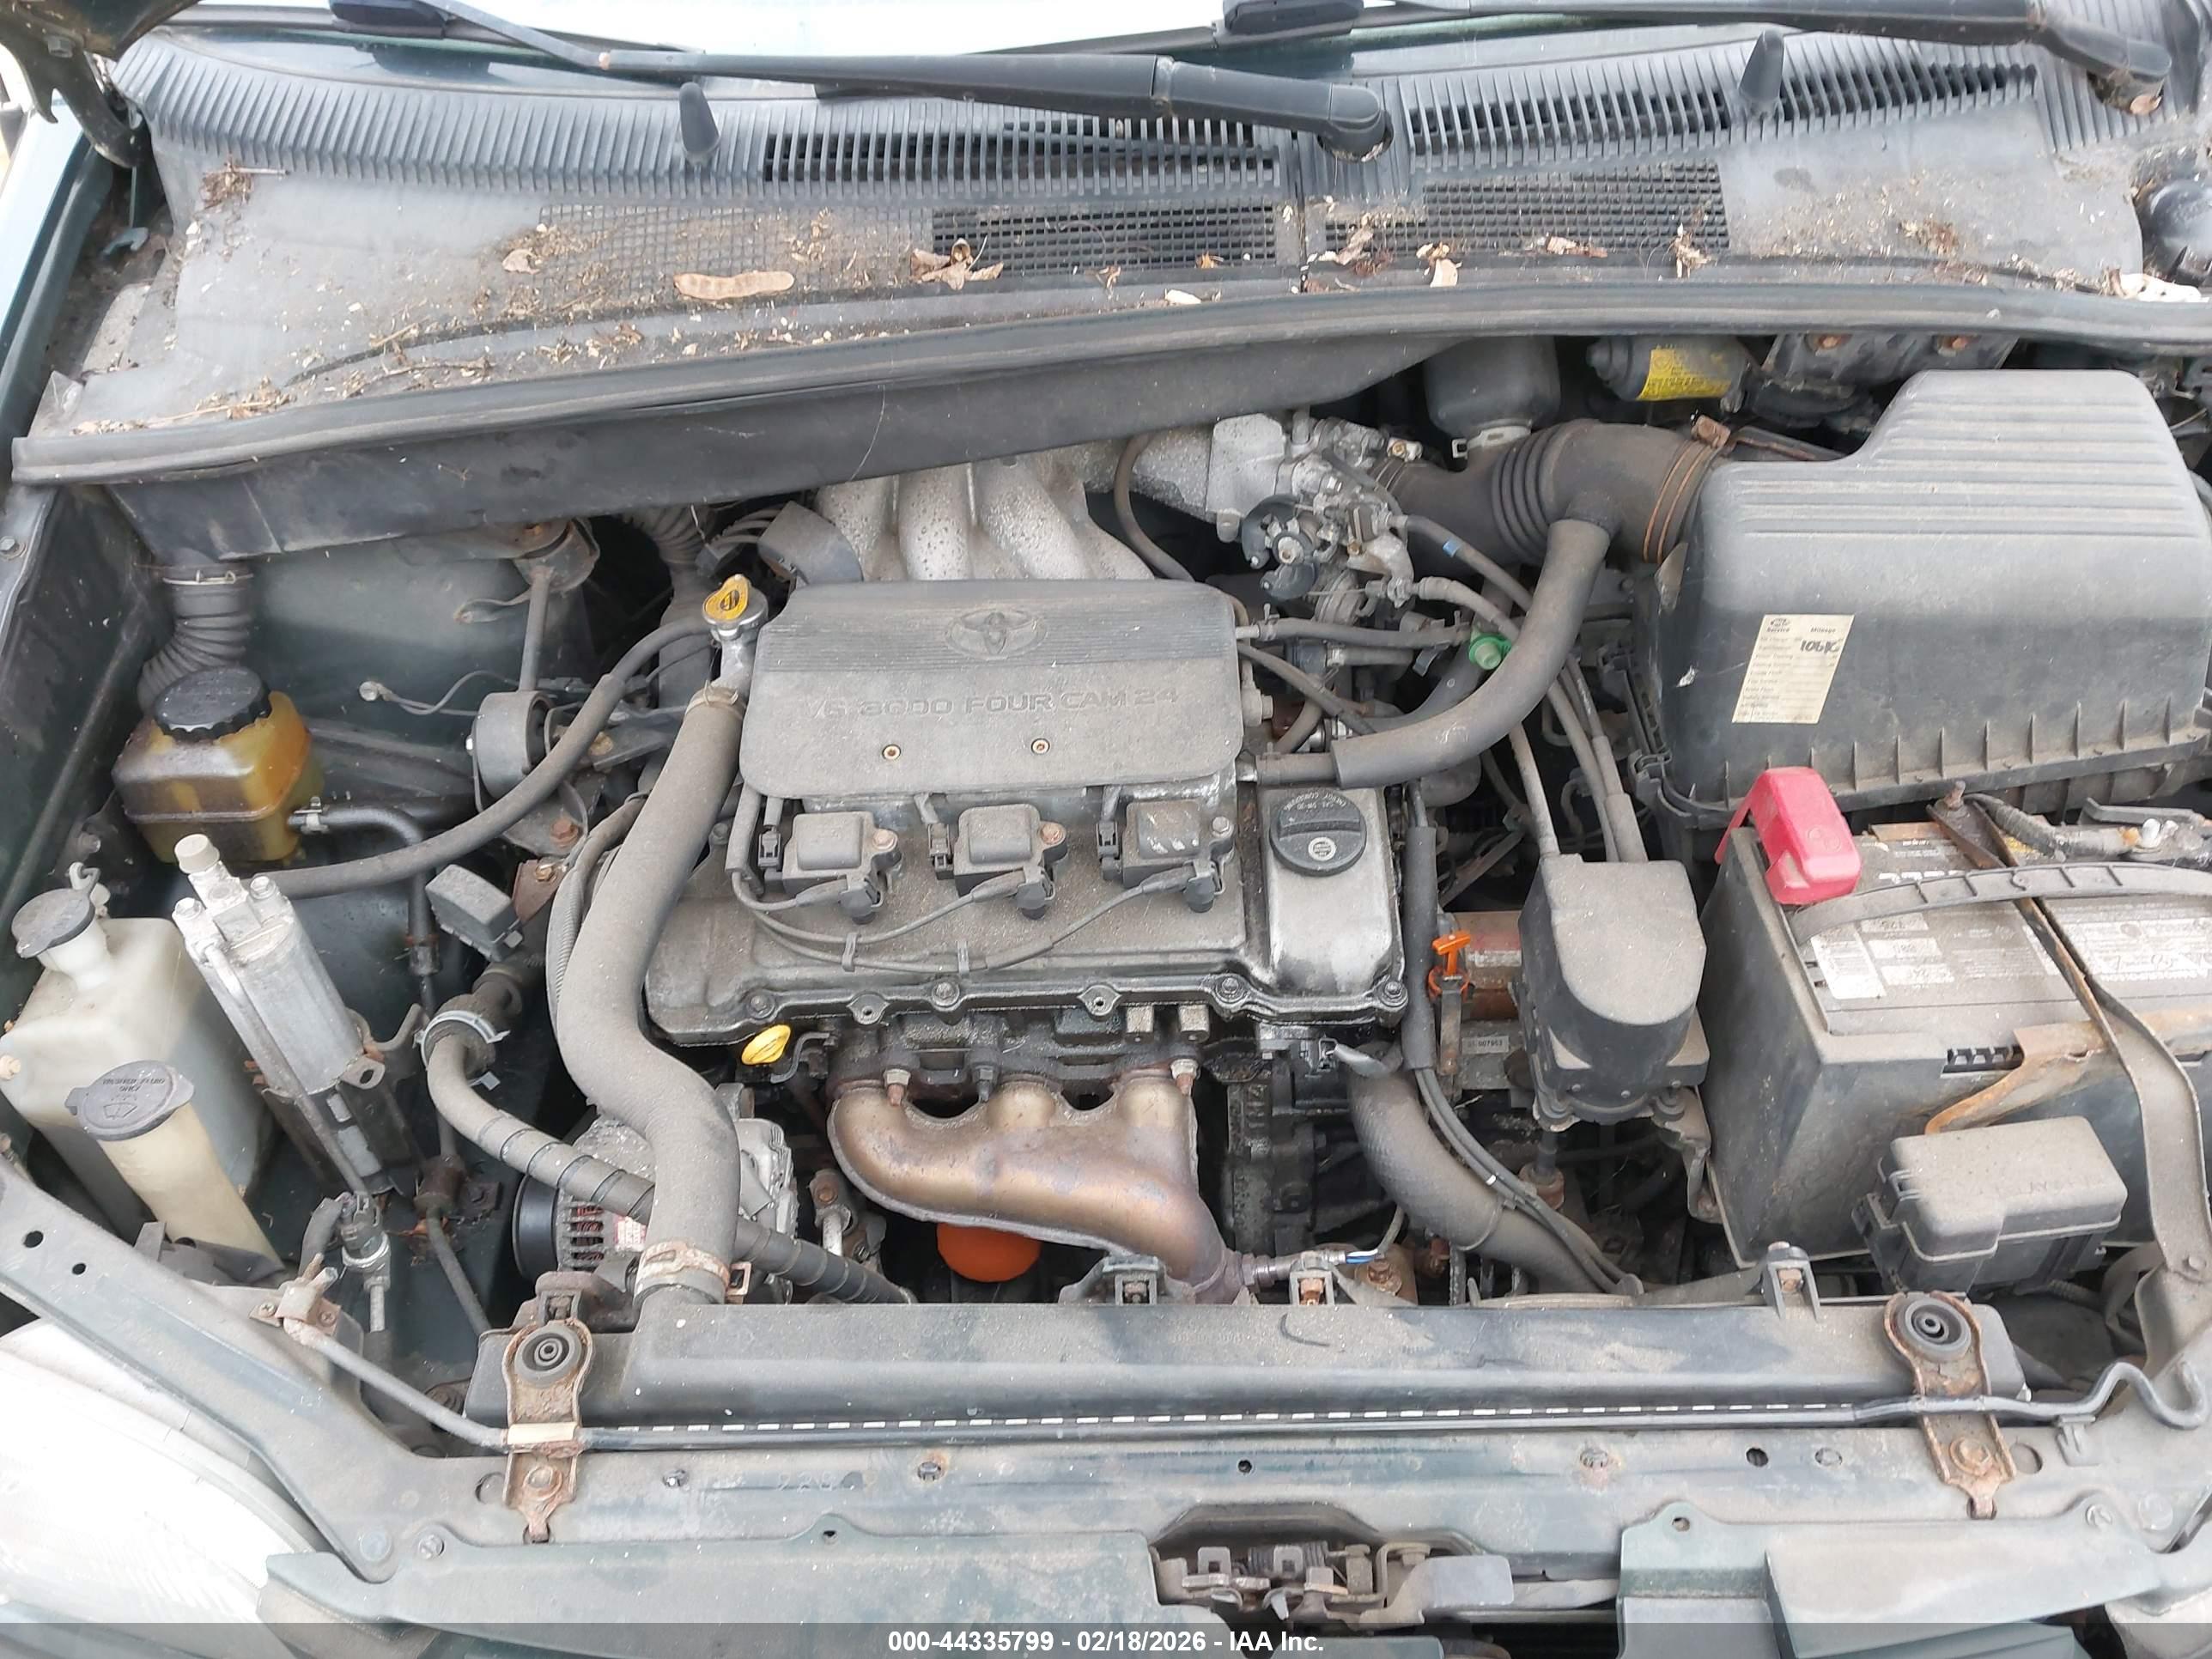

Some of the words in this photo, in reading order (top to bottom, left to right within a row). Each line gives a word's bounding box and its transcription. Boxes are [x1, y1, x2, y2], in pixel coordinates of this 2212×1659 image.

[858, 697, 953, 716] 3000
[965, 693, 1056, 715] FOUR
[1060, 690, 1127, 711] CAM
[1133, 686, 1178, 707] 24
